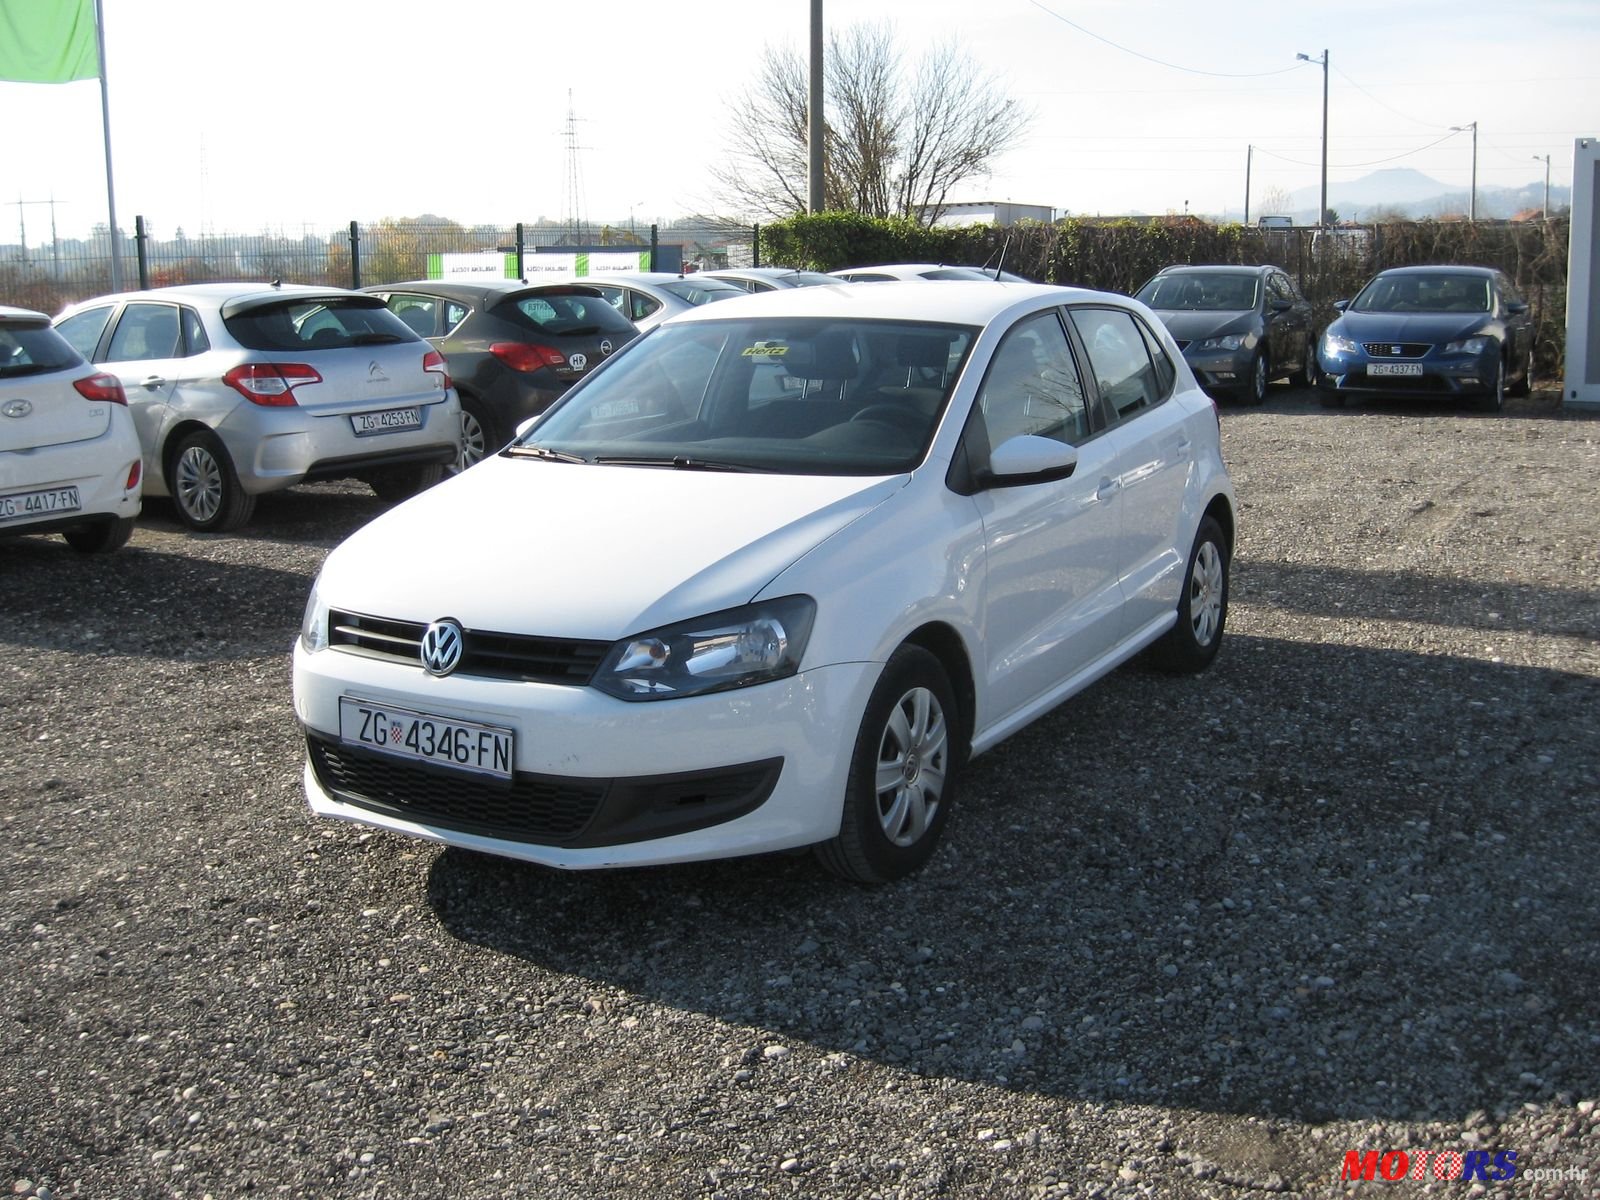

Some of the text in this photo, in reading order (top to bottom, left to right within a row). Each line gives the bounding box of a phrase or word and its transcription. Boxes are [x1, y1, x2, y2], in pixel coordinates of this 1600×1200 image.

[745, 347, 785, 355] Hertz
[572, 356, 584, 365] HR
[1373, 365, 1384, 374] ZG
[360, 416, 375, 429] ZG
[24, 490, 78, 512] 4417-FN
[359, 708, 509, 772] ZG 4346-FN
